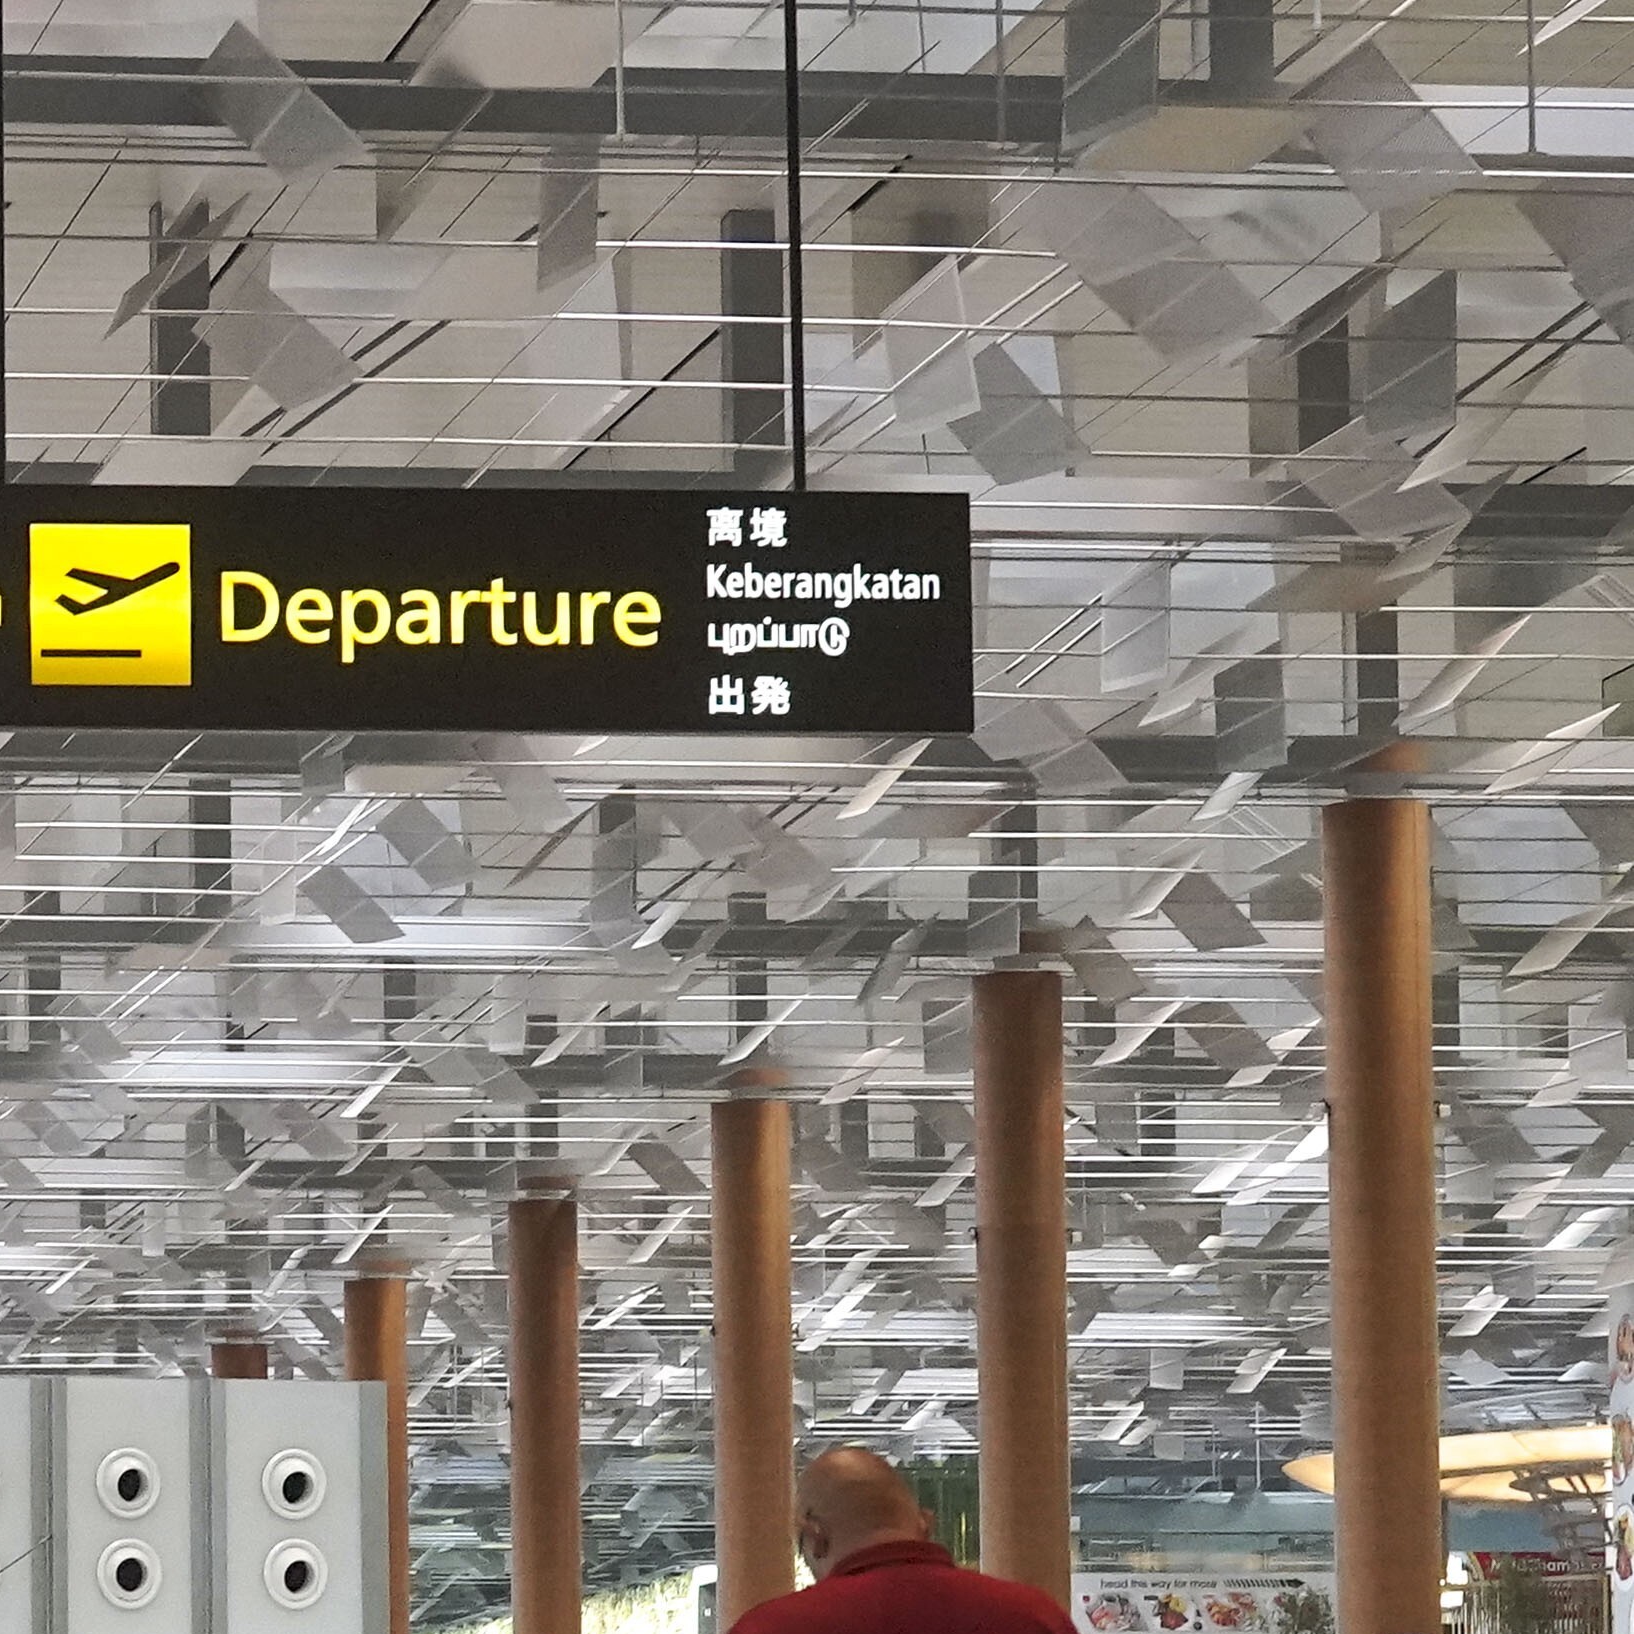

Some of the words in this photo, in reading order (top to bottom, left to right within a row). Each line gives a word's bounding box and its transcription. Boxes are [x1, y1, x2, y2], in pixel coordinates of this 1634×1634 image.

[706, 506, 788, 548] 离境
[706, 561, 941, 609] Keberangkatan
[220, 570, 662, 664] Departure
[708, 674, 791, 715] 出発
